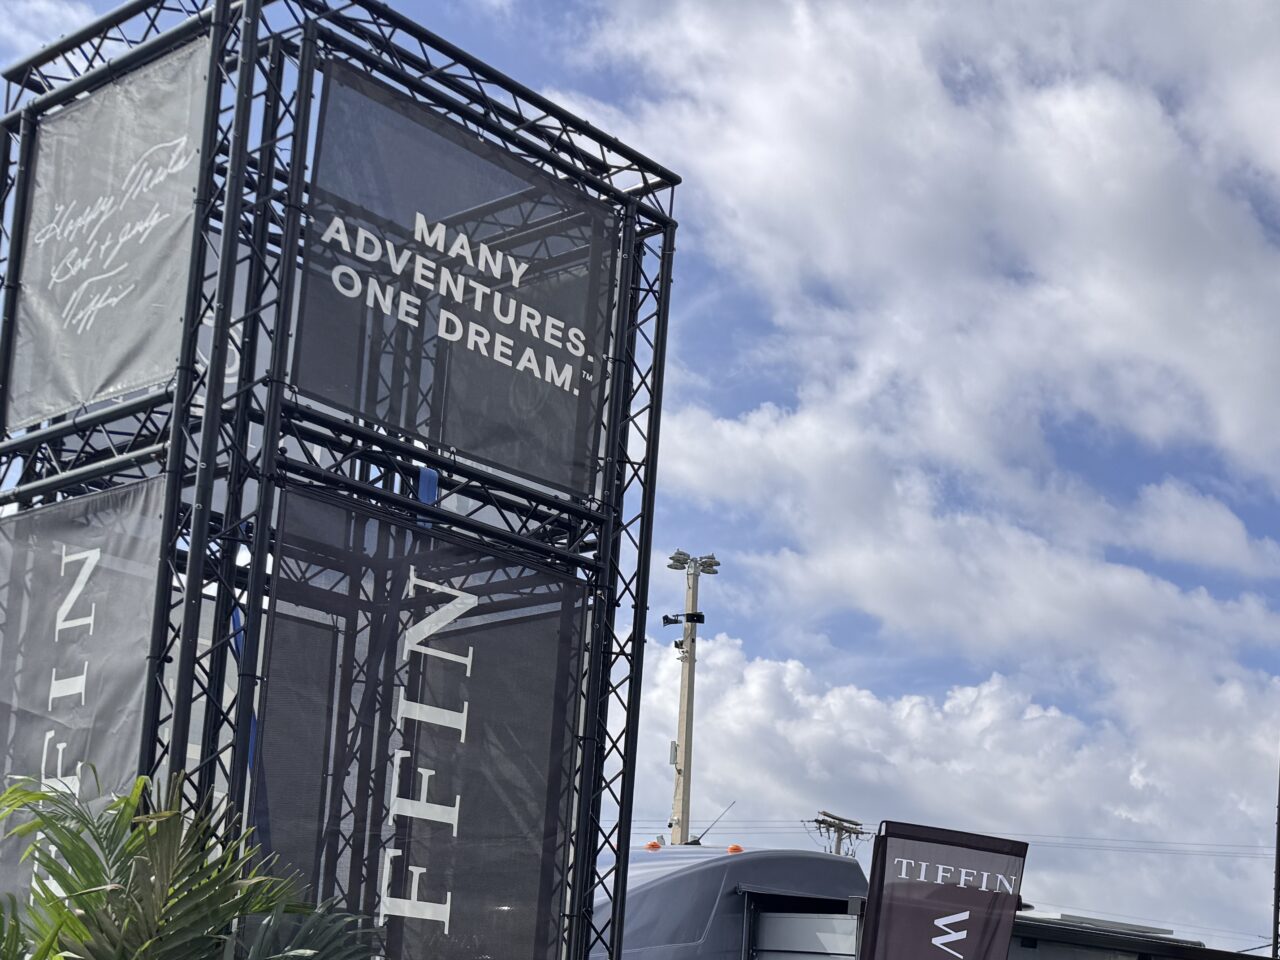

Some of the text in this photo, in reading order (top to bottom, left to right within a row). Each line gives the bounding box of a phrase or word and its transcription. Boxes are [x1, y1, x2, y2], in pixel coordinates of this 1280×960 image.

[414, 211, 529, 288] MANY
[320, 216, 594, 363] ADVENTURES.
[331, 264, 421, 328] ONE
[894, 858, 1017, 896] TIFFIN
